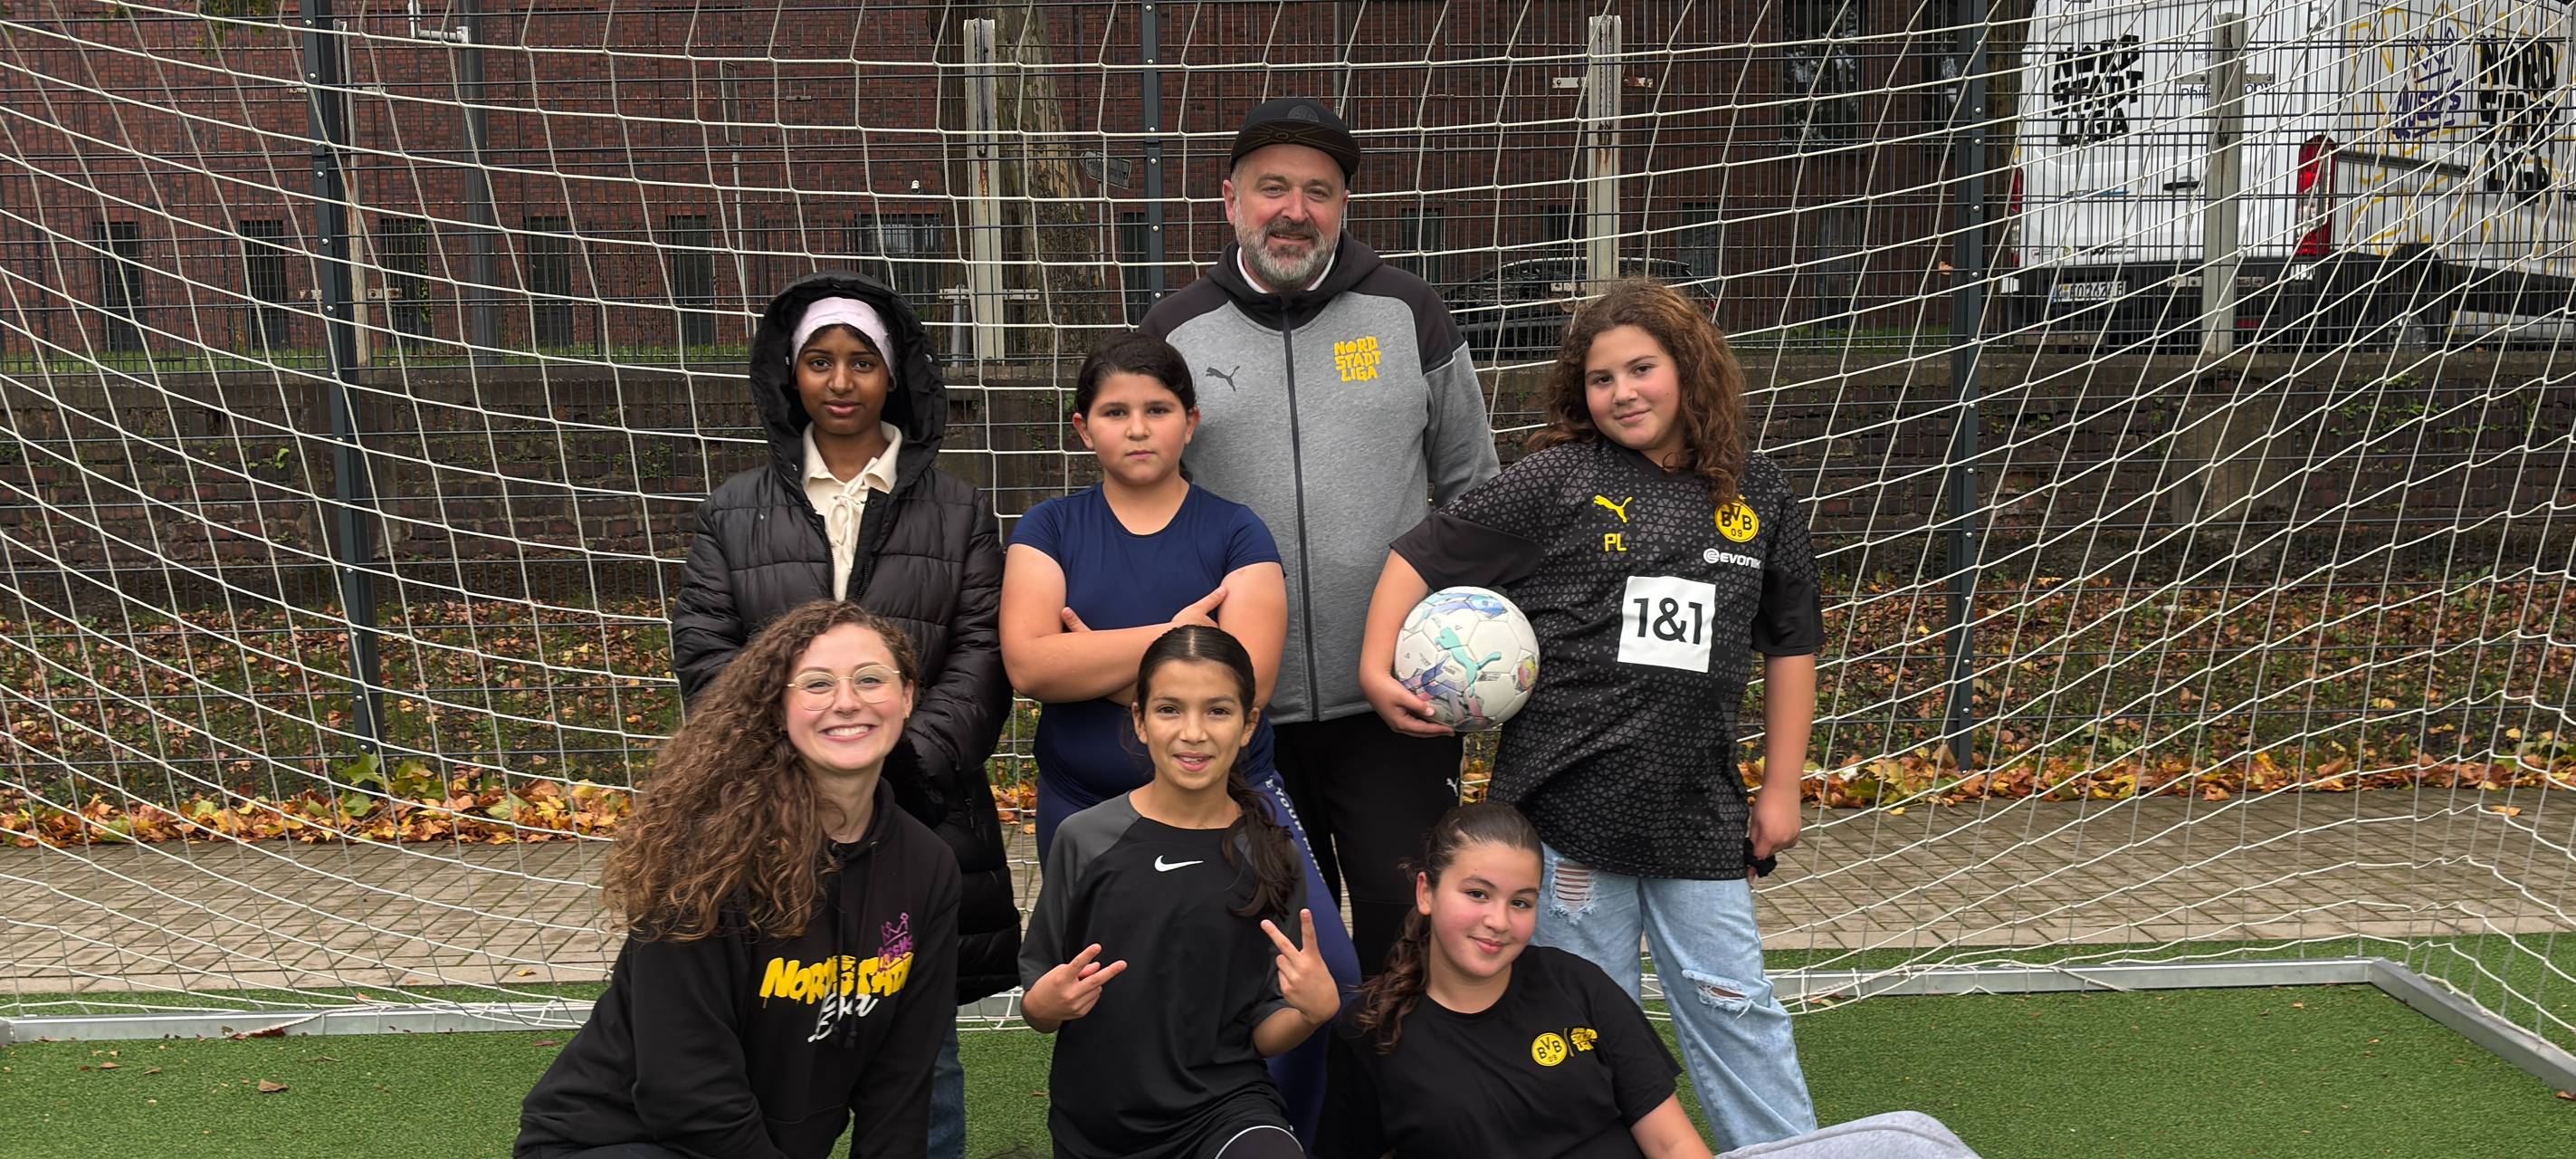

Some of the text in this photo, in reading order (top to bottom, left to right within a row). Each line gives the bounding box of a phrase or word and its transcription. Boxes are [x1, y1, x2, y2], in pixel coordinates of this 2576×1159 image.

[2054, 35, 2140, 80] NORD
[2052, 71, 2144, 116] STADT
[2057, 108, 2130, 147] LIGA
[1334, 336, 1379, 356] NORD
[1335, 350, 1381, 370] STADT
[1341, 366, 1379, 382] LIGA
[1721, 503, 1752, 531] BVB
[1604, 532, 1627, 551] PL
[1731, 528, 1743, 538] 09
[1633, 597, 1703, 645] 1&1
[1536, 1037, 1562, 1059] BVB
